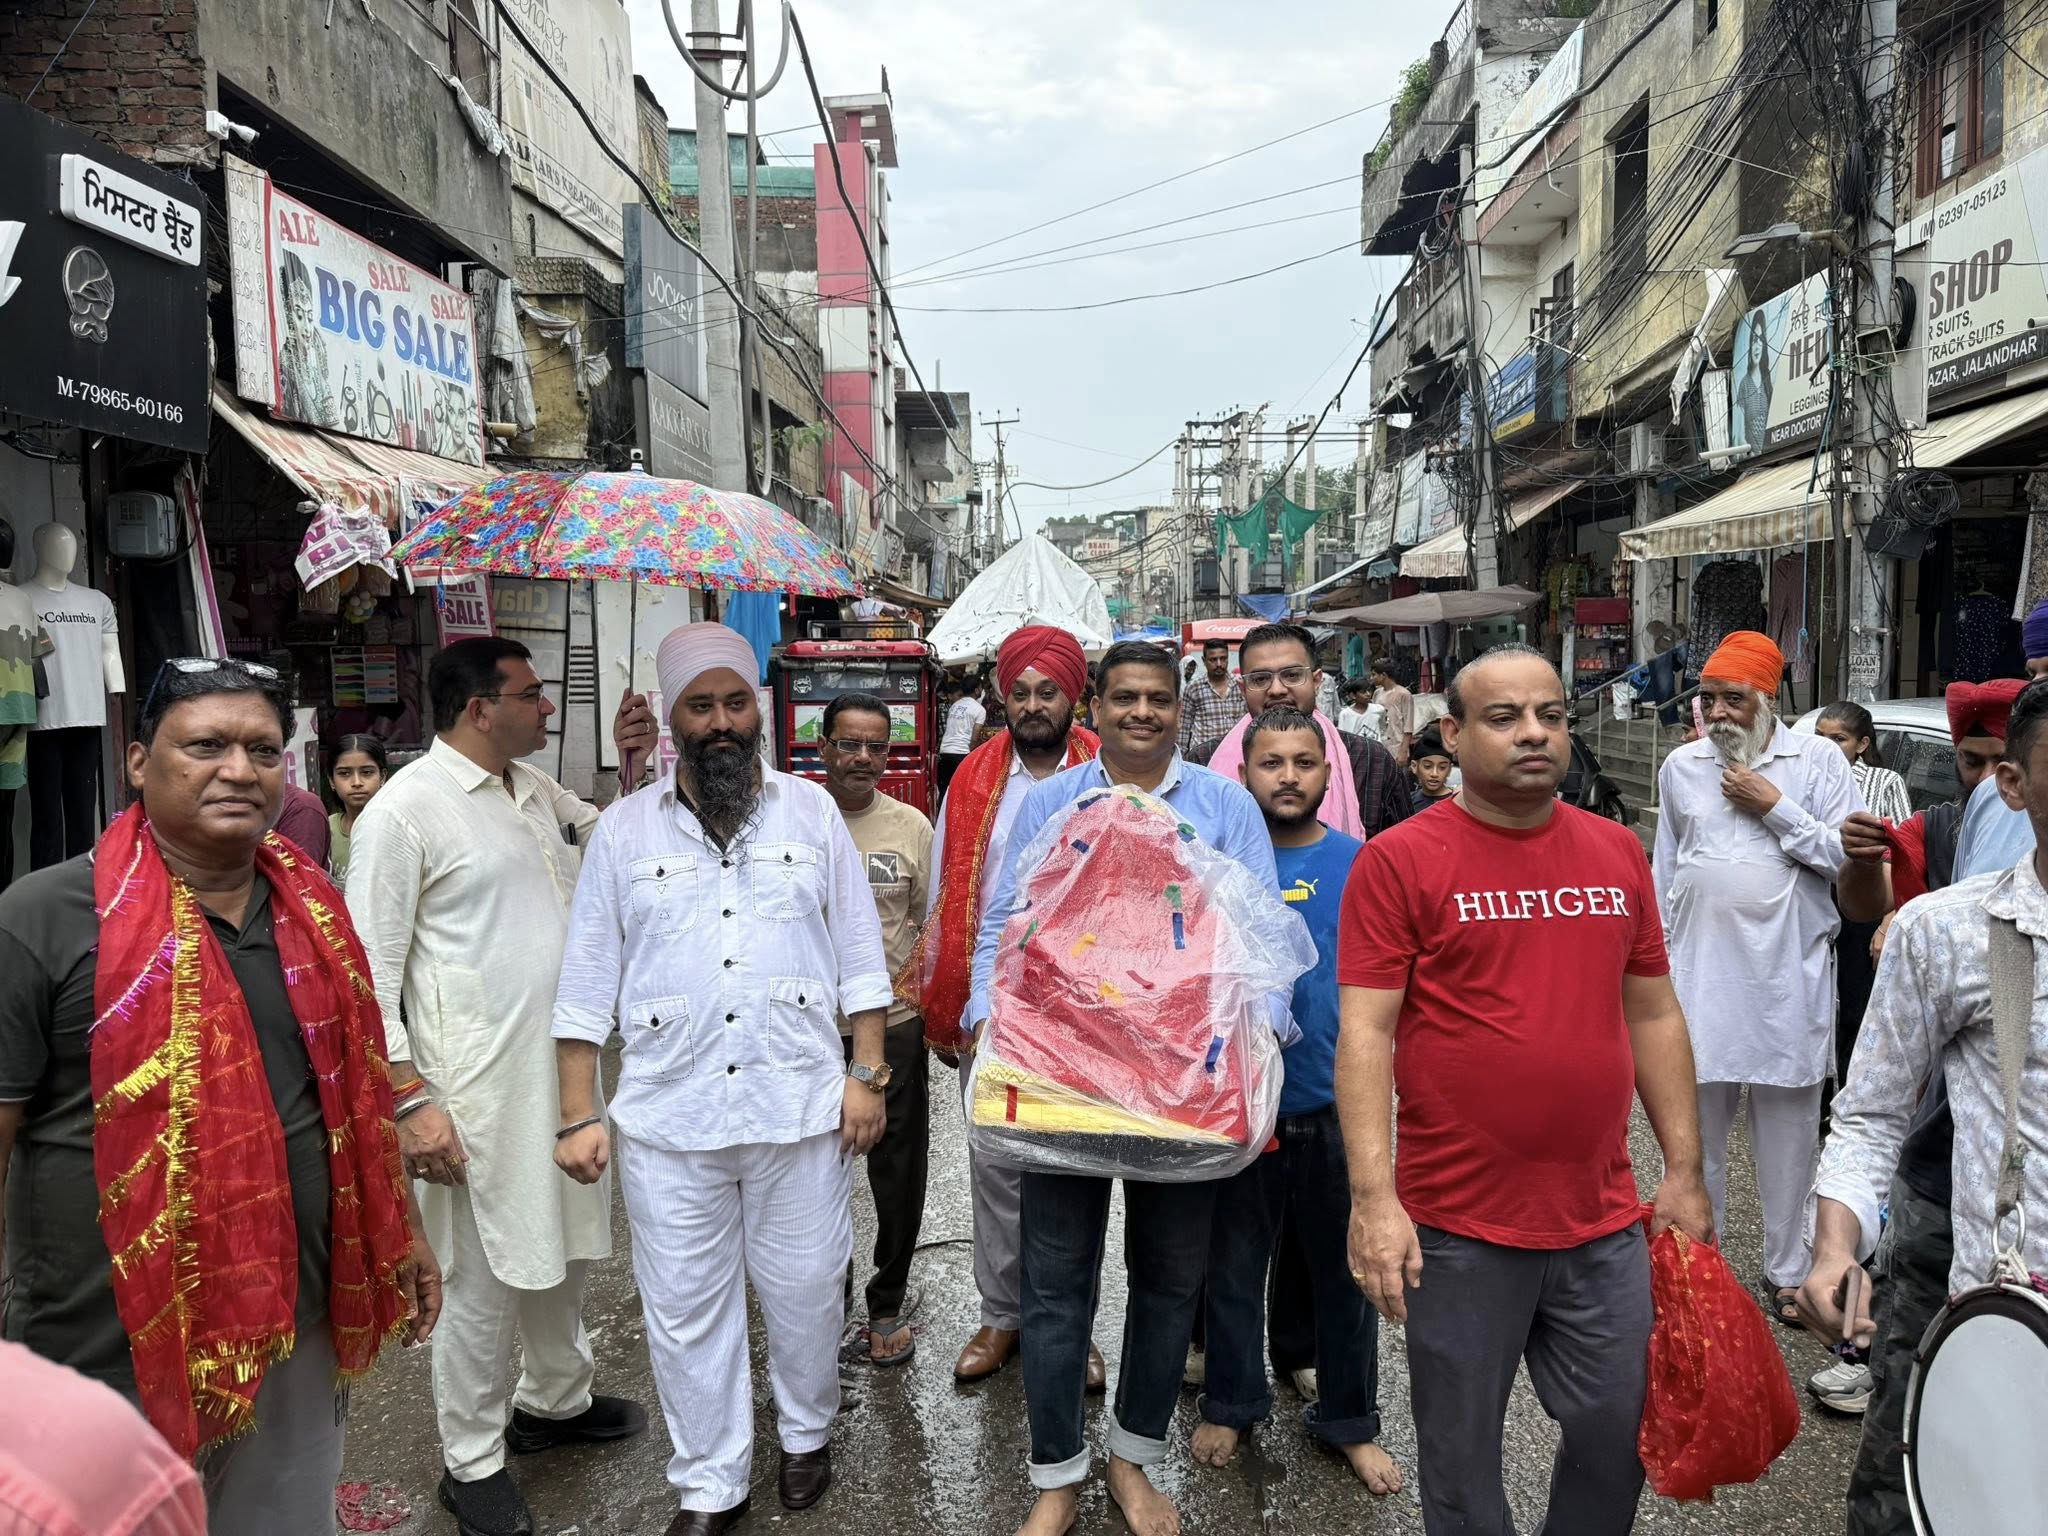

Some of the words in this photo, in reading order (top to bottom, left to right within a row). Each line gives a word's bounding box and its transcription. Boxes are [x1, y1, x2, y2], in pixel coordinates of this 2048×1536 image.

[82, 168, 158, 233] ਮਿਸਟਰ
[1938, 179, 2007, 229] 62397-05123
[368, 261, 411, 293] SALE
[1929, 237, 2013, 320] SHOP
[431, 293, 466, 320] SALE
[647, 272, 694, 325] JOCKEY
[315, 265, 387, 350] BIG
[392, 304, 472, 385] SALE
[1936, 310, 1973, 338] SUITS,
[1968, 319, 2005, 347] SUITS
[1962, 335, 2038, 377] JALANDHAR
[57, 375, 183, 424] M-79865-60166
[1789, 389, 1830, 416] LEGGINGS
[1770, 426, 1790, 445] NEAR
[1790, 414, 1822, 437] DOCTOR
[44, 611, 96, 625] Columbia
[445, 599, 486, 626] SALE
[1851, 655, 1876, 667] LOAN
[1453, 886, 1630, 923] HILFIGER
